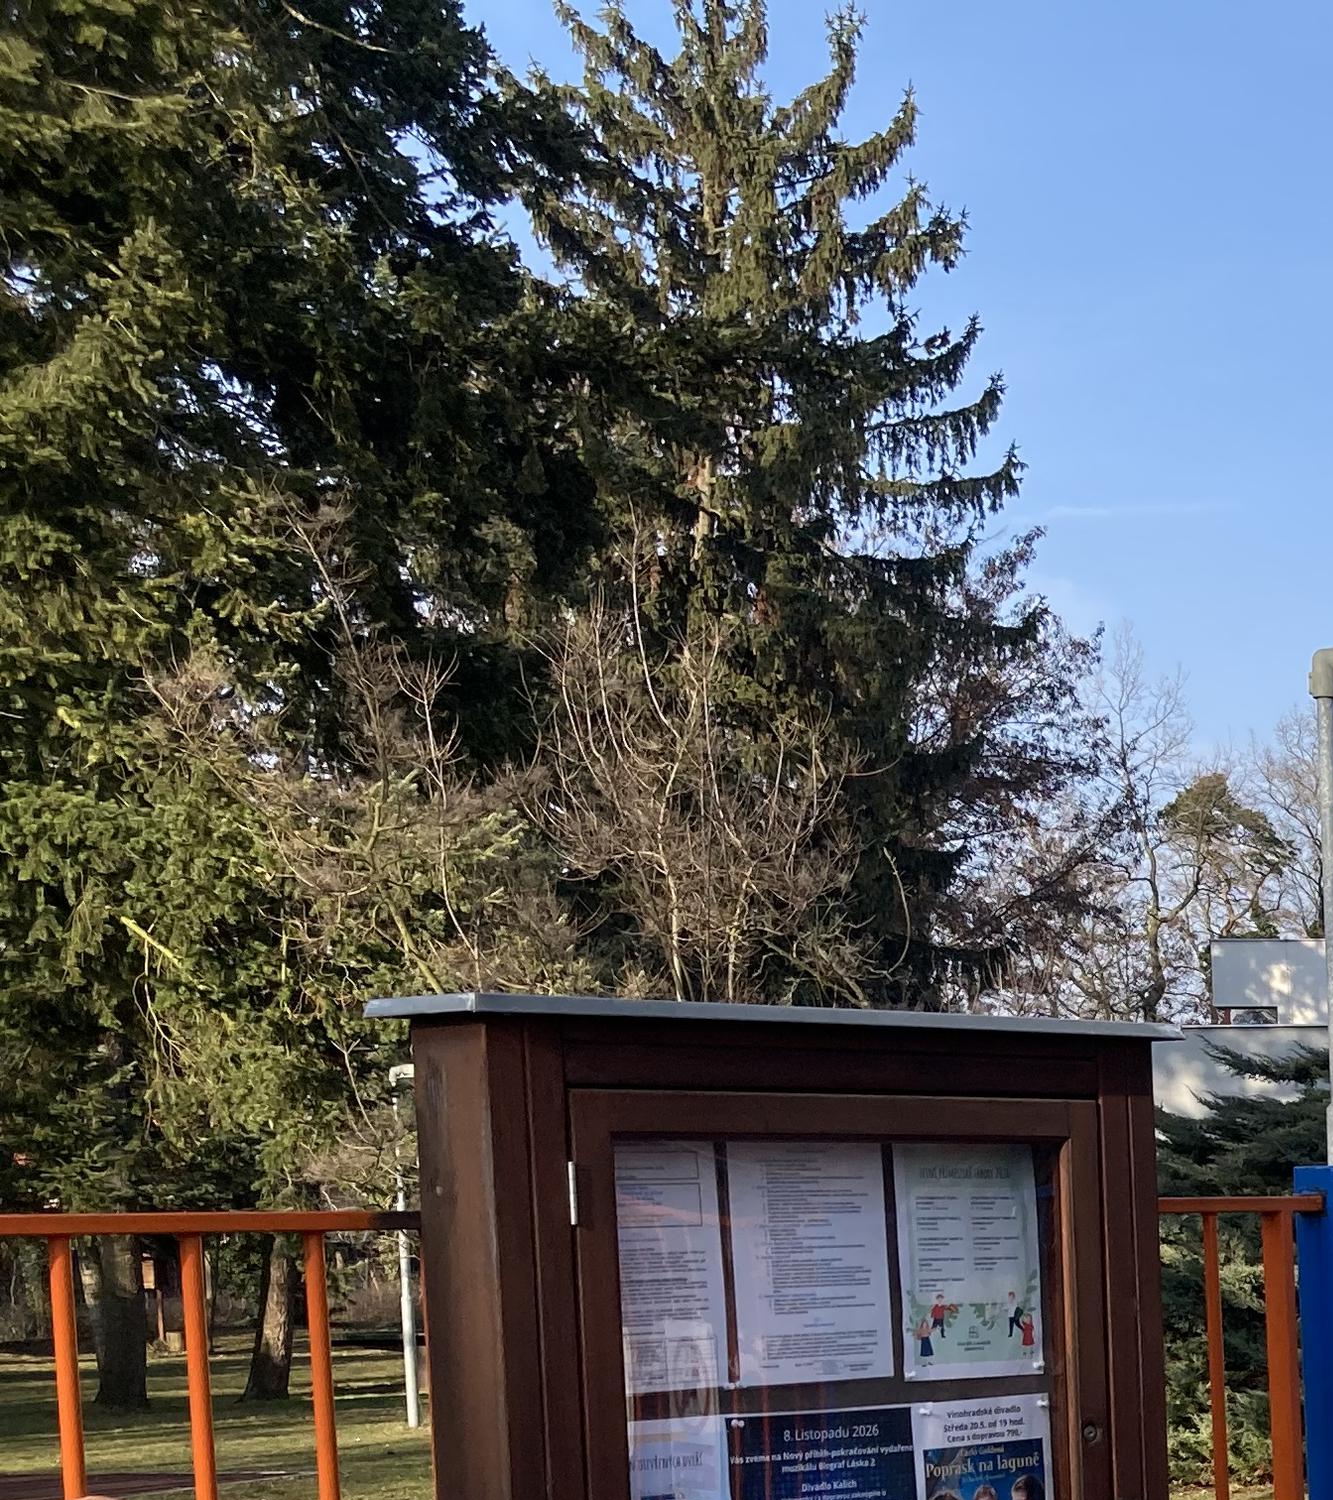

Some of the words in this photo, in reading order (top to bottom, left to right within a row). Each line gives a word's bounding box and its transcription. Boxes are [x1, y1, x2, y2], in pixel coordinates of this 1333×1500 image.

[947, 1407, 993, 1419] Vinohradské
[994, 1405, 1021, 1415] divadlo
[784, 1430, 794, 1442] 8.
[795, 1426, 850, 1442] Listopadu
[852, 1424, 880, 1437] 2026
[944, 1422, 969, 1433] Středa
[988, 1420, 997, 1428] od
[947, 1434, 966, 1443] Cena
[972, 1431, 1005, 1443] dopravou
[745, 1455, 771, 1464] zveme
[771, 1453, 782, 1461] na
[783, 1450, 803, 1462] Nový
[869, 1458, 876, 1467] 2
[926, 1458, 975, 1482] Poprask
[979, 1459, 994, 1472] na
[997, 1452, 1041, 1473] laguně
[802, 1482, 832, 1493] Divadlo
[833, 1480, 858, 1492] Kalich
